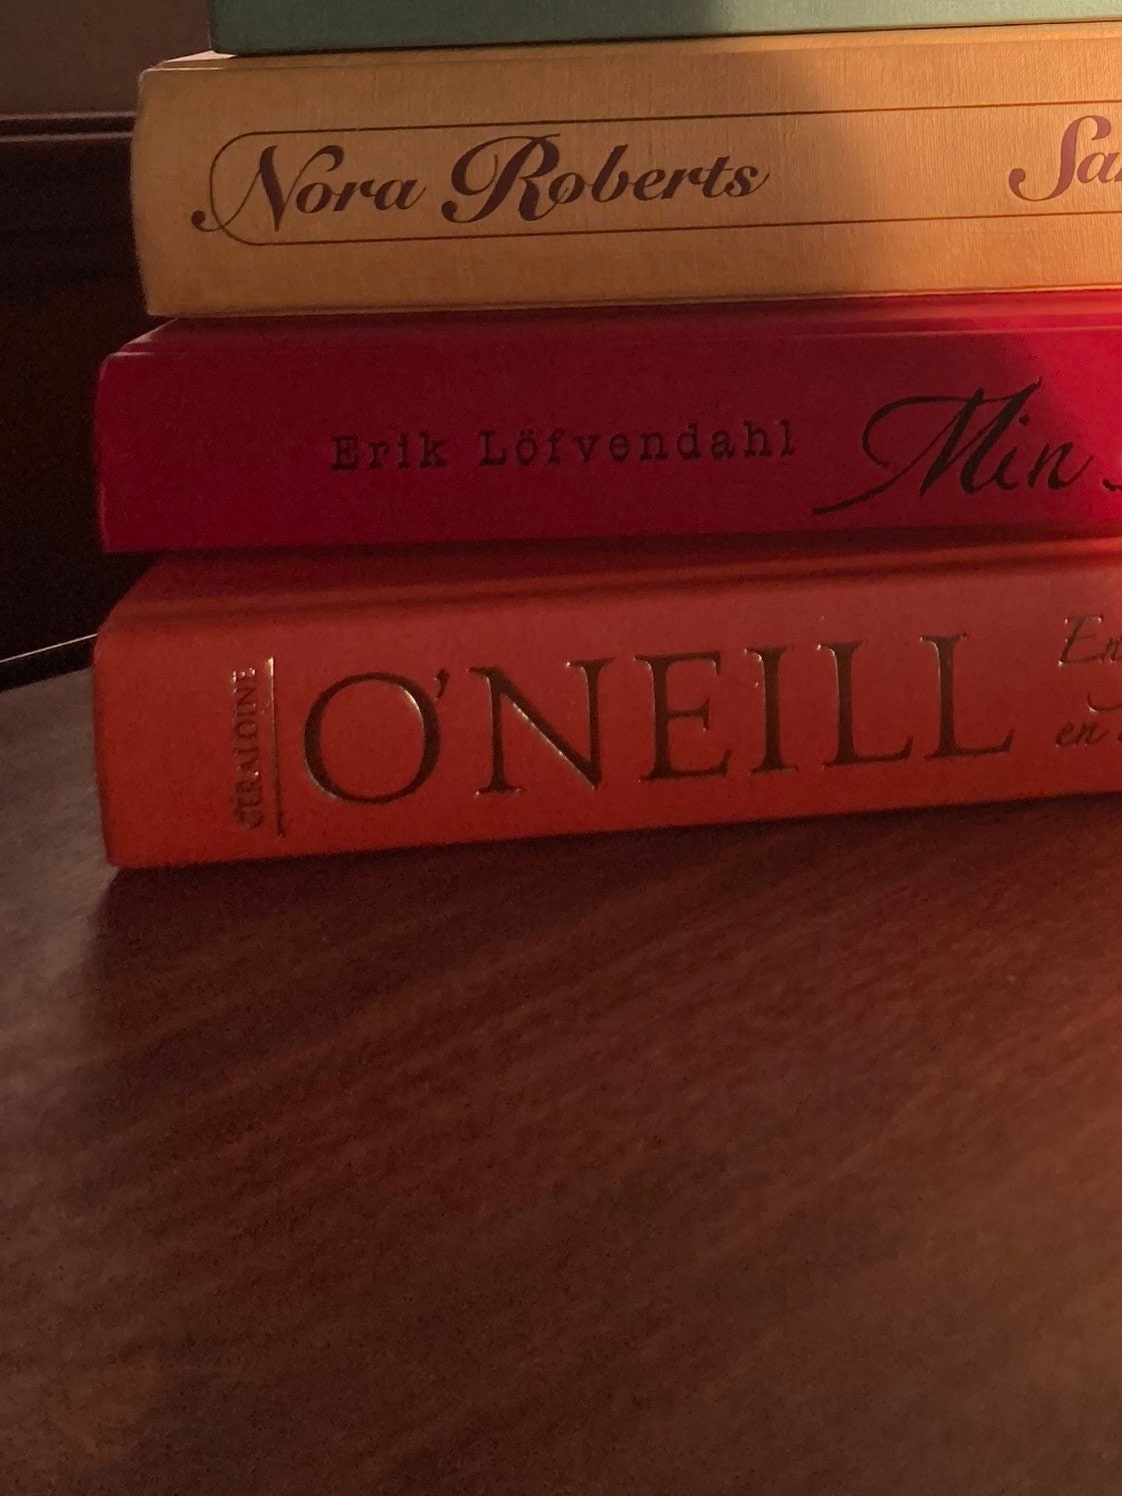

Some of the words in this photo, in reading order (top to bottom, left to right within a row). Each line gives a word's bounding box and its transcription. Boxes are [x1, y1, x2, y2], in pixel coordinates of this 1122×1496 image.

[190, 144, 427, 232] Nora
[440, 133, 770, 223] Roberts
[328, 430, 447, 472] Erik
[477, 419, 796, 468] Löfvendahl
[812, 376, 1094, 515] Min
[301, 632, 1016, 806] O'NEILL
[1055, 717, 1112, 749] en
